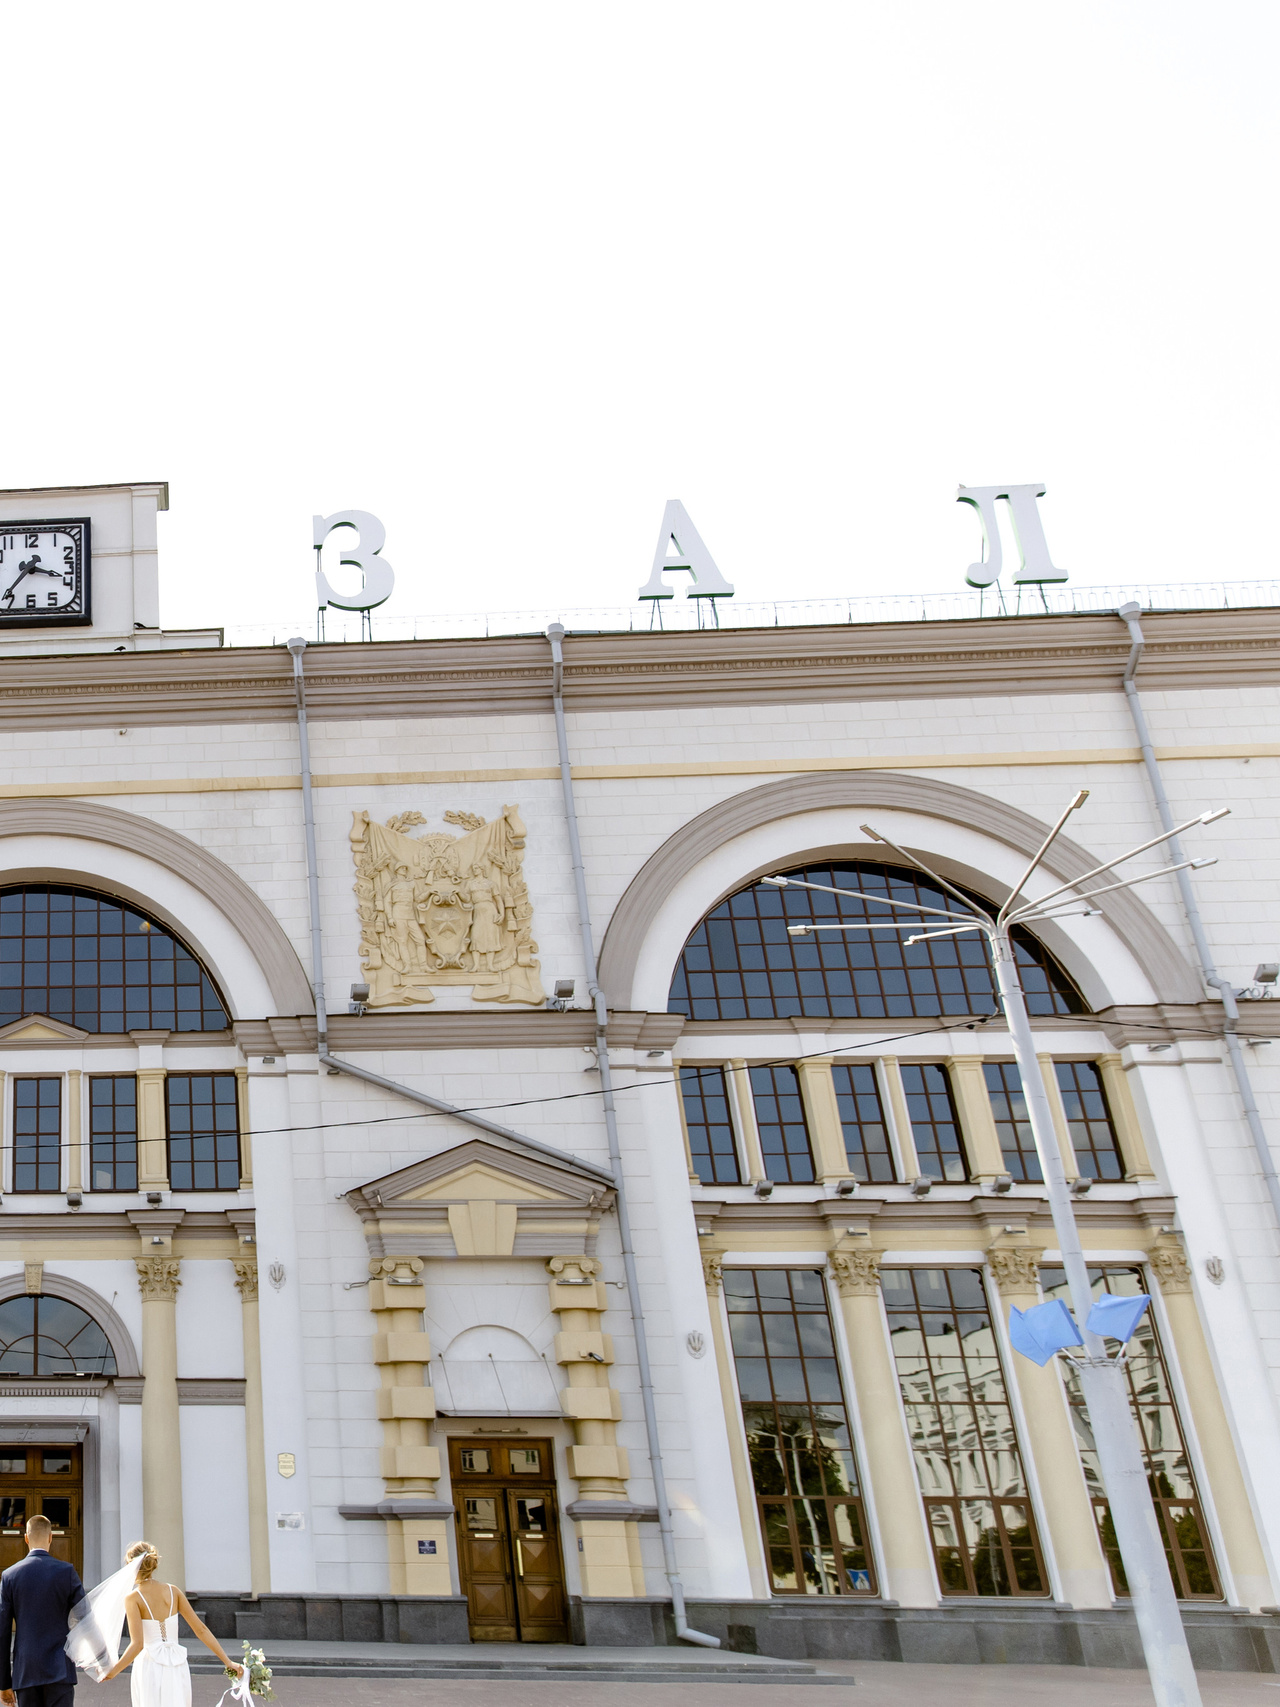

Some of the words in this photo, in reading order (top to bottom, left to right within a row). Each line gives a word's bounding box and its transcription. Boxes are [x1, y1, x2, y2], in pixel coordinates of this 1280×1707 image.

[3, 535, 13, 550] 11
[24, 533, 39, 549] 12
[63, 546, 74, 560] 2
[64, 560, 75, 575] 3
[63, 576, 73, 591] 4
[5, 594, 15, 609] 7
[26, 594, 36, 608] 6
[47, 592, 58, 606] 5
